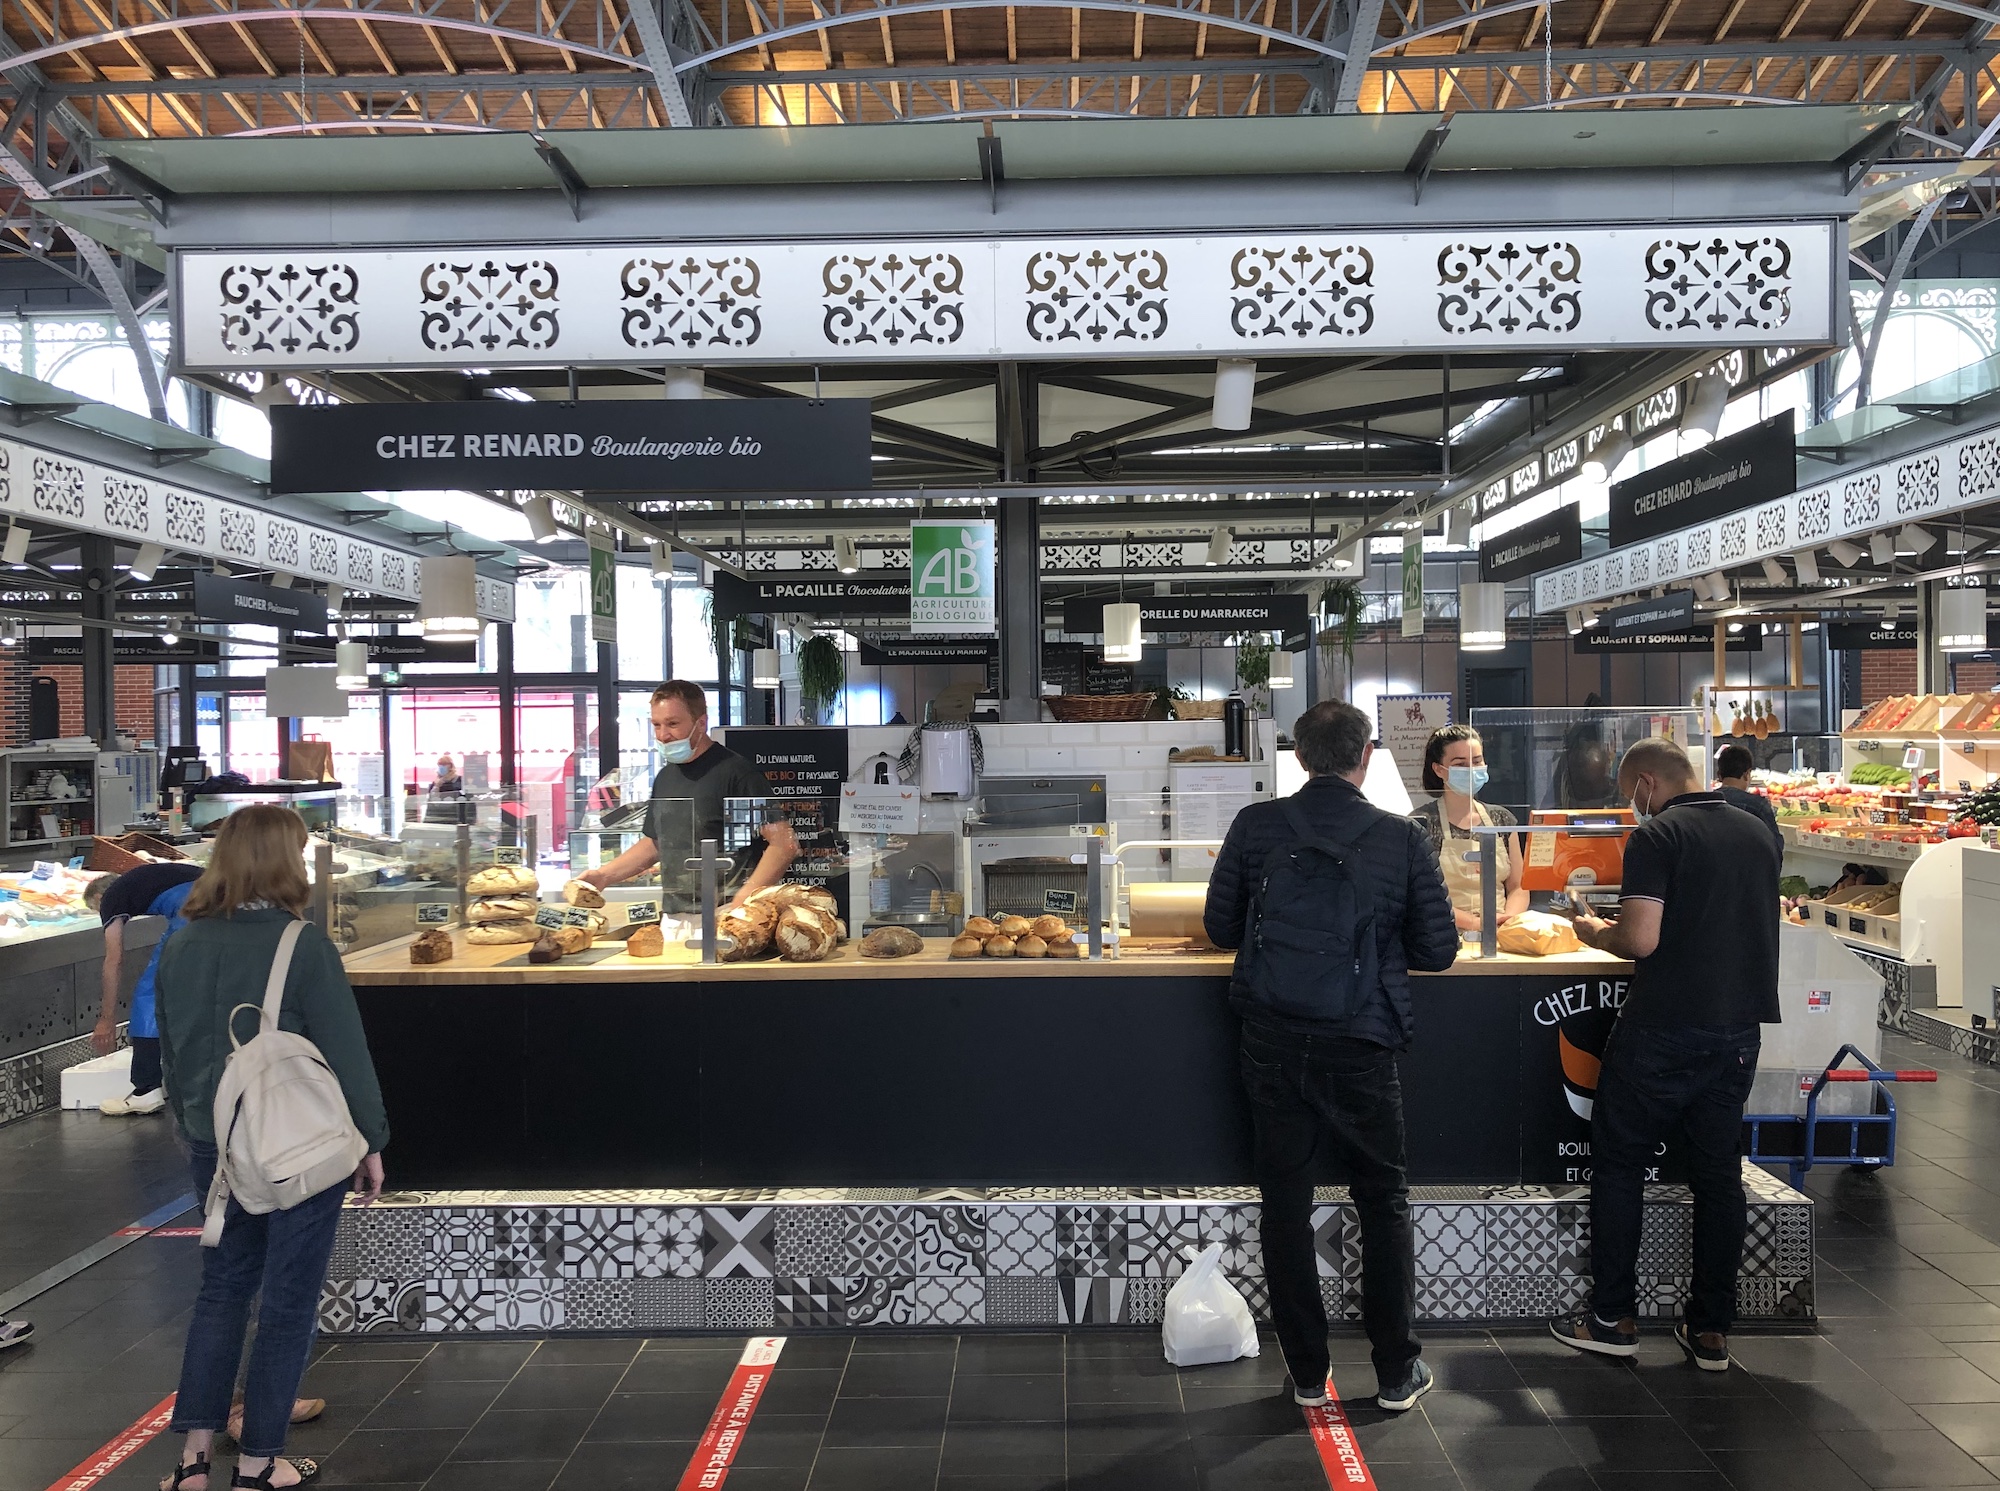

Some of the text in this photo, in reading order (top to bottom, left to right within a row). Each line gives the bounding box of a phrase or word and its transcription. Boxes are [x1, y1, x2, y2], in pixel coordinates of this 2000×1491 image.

[376, 433, 762, 461] CHEZ RENARD Boulangerie bio
[1634, 460, 1752, 516] CHEZ RENARD Boulangerie bio
[1495, 545, 1518, 567] PACAILLE
[919, 547, 981, 594] AB
[593, 570, 613, 614] AB
[760, 584, 911, 598] L. PACAILLE Chocolaterie
[1403, 563, 1420, 609] AB
[235, 594, 267, 612] FAUCHER
[912, 600, 993, 609] AGRICULTURE
[912, 611, 993, 620] BIOLOGIQUE
[1182, 609, 1198, 619] DU
[1200, 608, 1269, 618] MARRAKECH
[1635, 635, 1646, 644] ET
[1648, 634, 1688, 644] SOPHAN
[1870, 631, 1896, 640] CHEZ
[767, 754, 788, 764] LEVAIN
[789, 754, 816, 763] NATUREL
[781, 770, 796, 780] BIO
[797, 771, 805, 780] ET
[806, 770, 840, 780] PAYSANNES
[796, 785, 823, 795] EPAISSES
[795, 816, 816, 826] SEIGLE
[795, 863, 808, 872] DES
[809, 862, 831, 872] FIGUES
[1048, 891, 1068, 900] BUNS
[1533, 983, 1592, 1026] CHEZ
[1566, 1167, 1580, 1182] ET
[1324, 1412, 1345, 1423] À
[697, 1374, 765, 1489] DISTANCE À RESPECTER
[1328, 1424, 1367, 1484] RESPECTER
